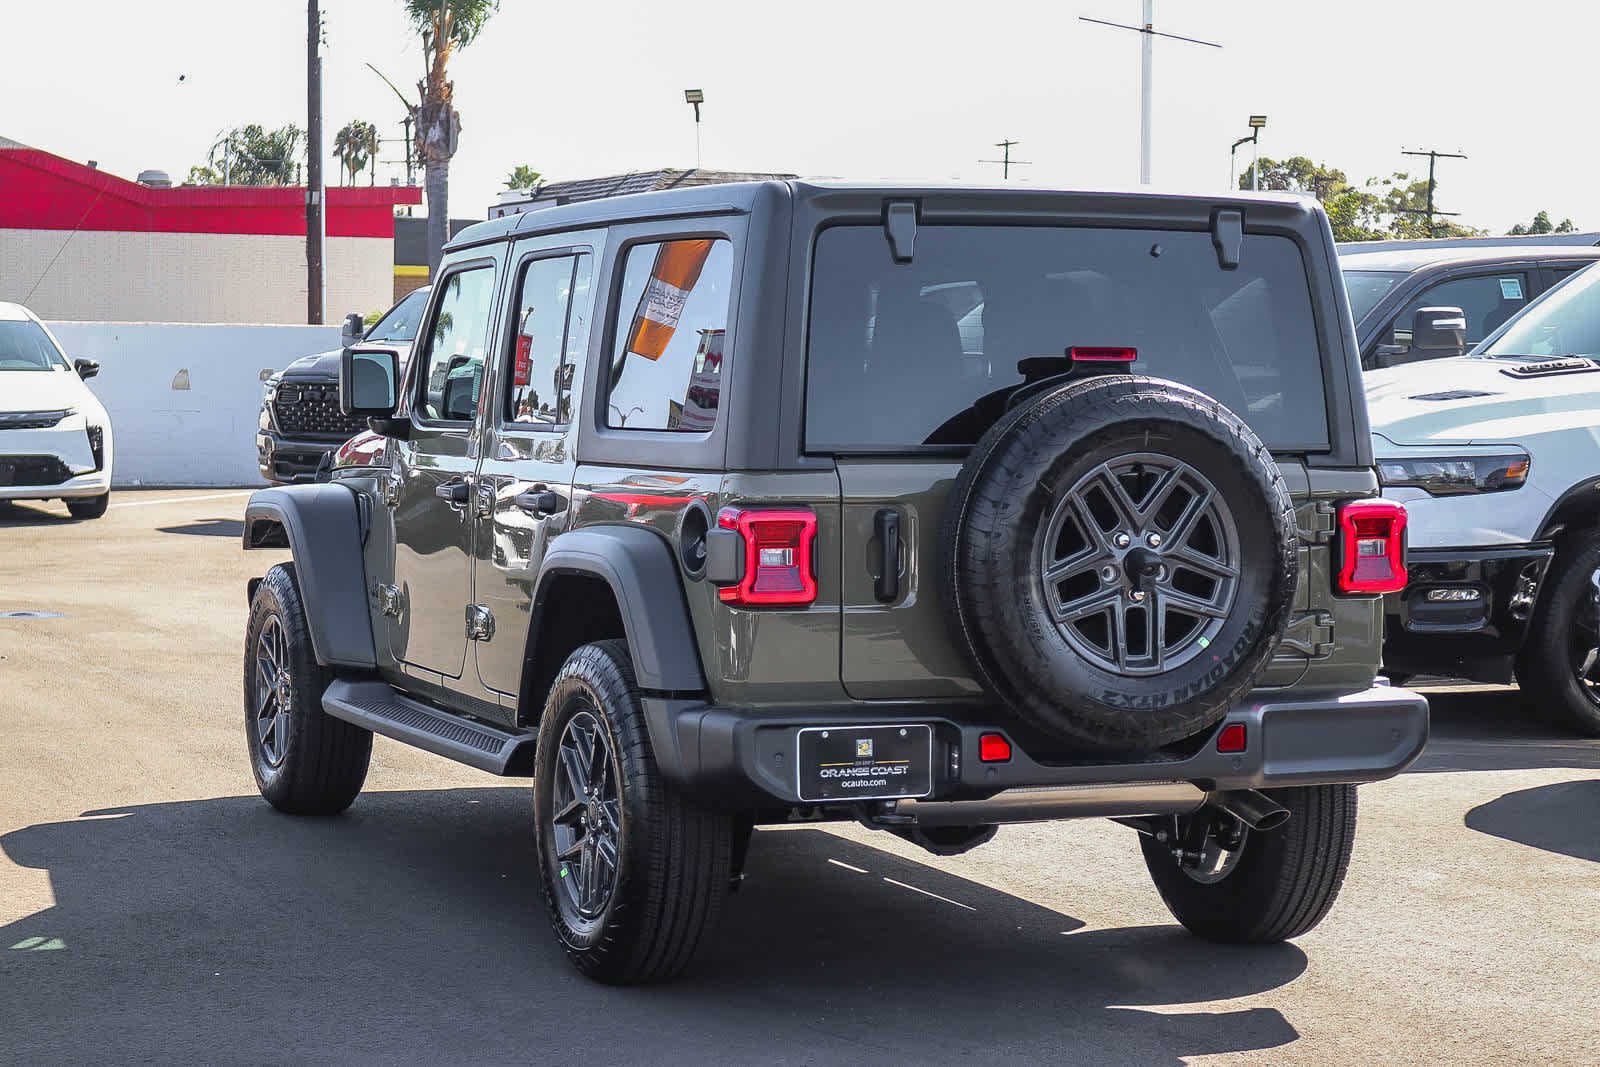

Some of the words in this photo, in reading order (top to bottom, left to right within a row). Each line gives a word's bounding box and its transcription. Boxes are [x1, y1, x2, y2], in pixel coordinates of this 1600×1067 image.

[820, 766, 870, 778] ORANGE
[870, 765, 909, 776] COAST
[841, 779, 887, 788] ocauto.com
